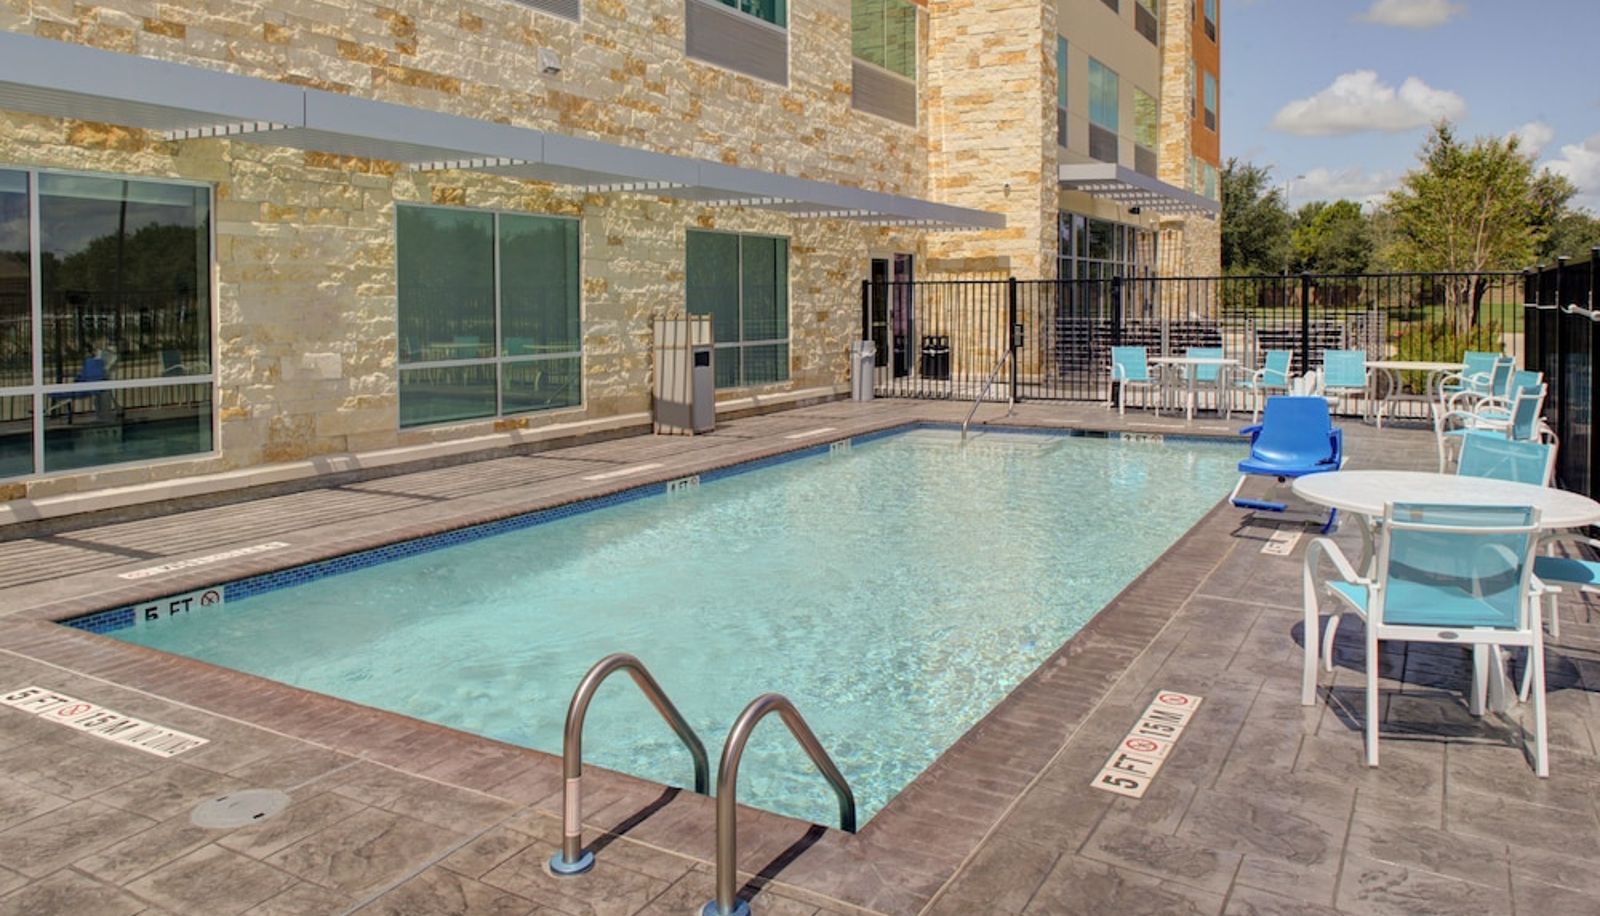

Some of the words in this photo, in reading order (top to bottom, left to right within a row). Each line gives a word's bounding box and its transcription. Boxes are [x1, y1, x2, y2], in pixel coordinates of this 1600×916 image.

[145, 606, 159, 621] 5
[169, 597, 193, 616] FT
[6, 689, 40, 701] 5
[22, 694, 69, 711] FT
[1112, 753, 1153, 775] FT
[1102, 774, 1139, 789] 5
